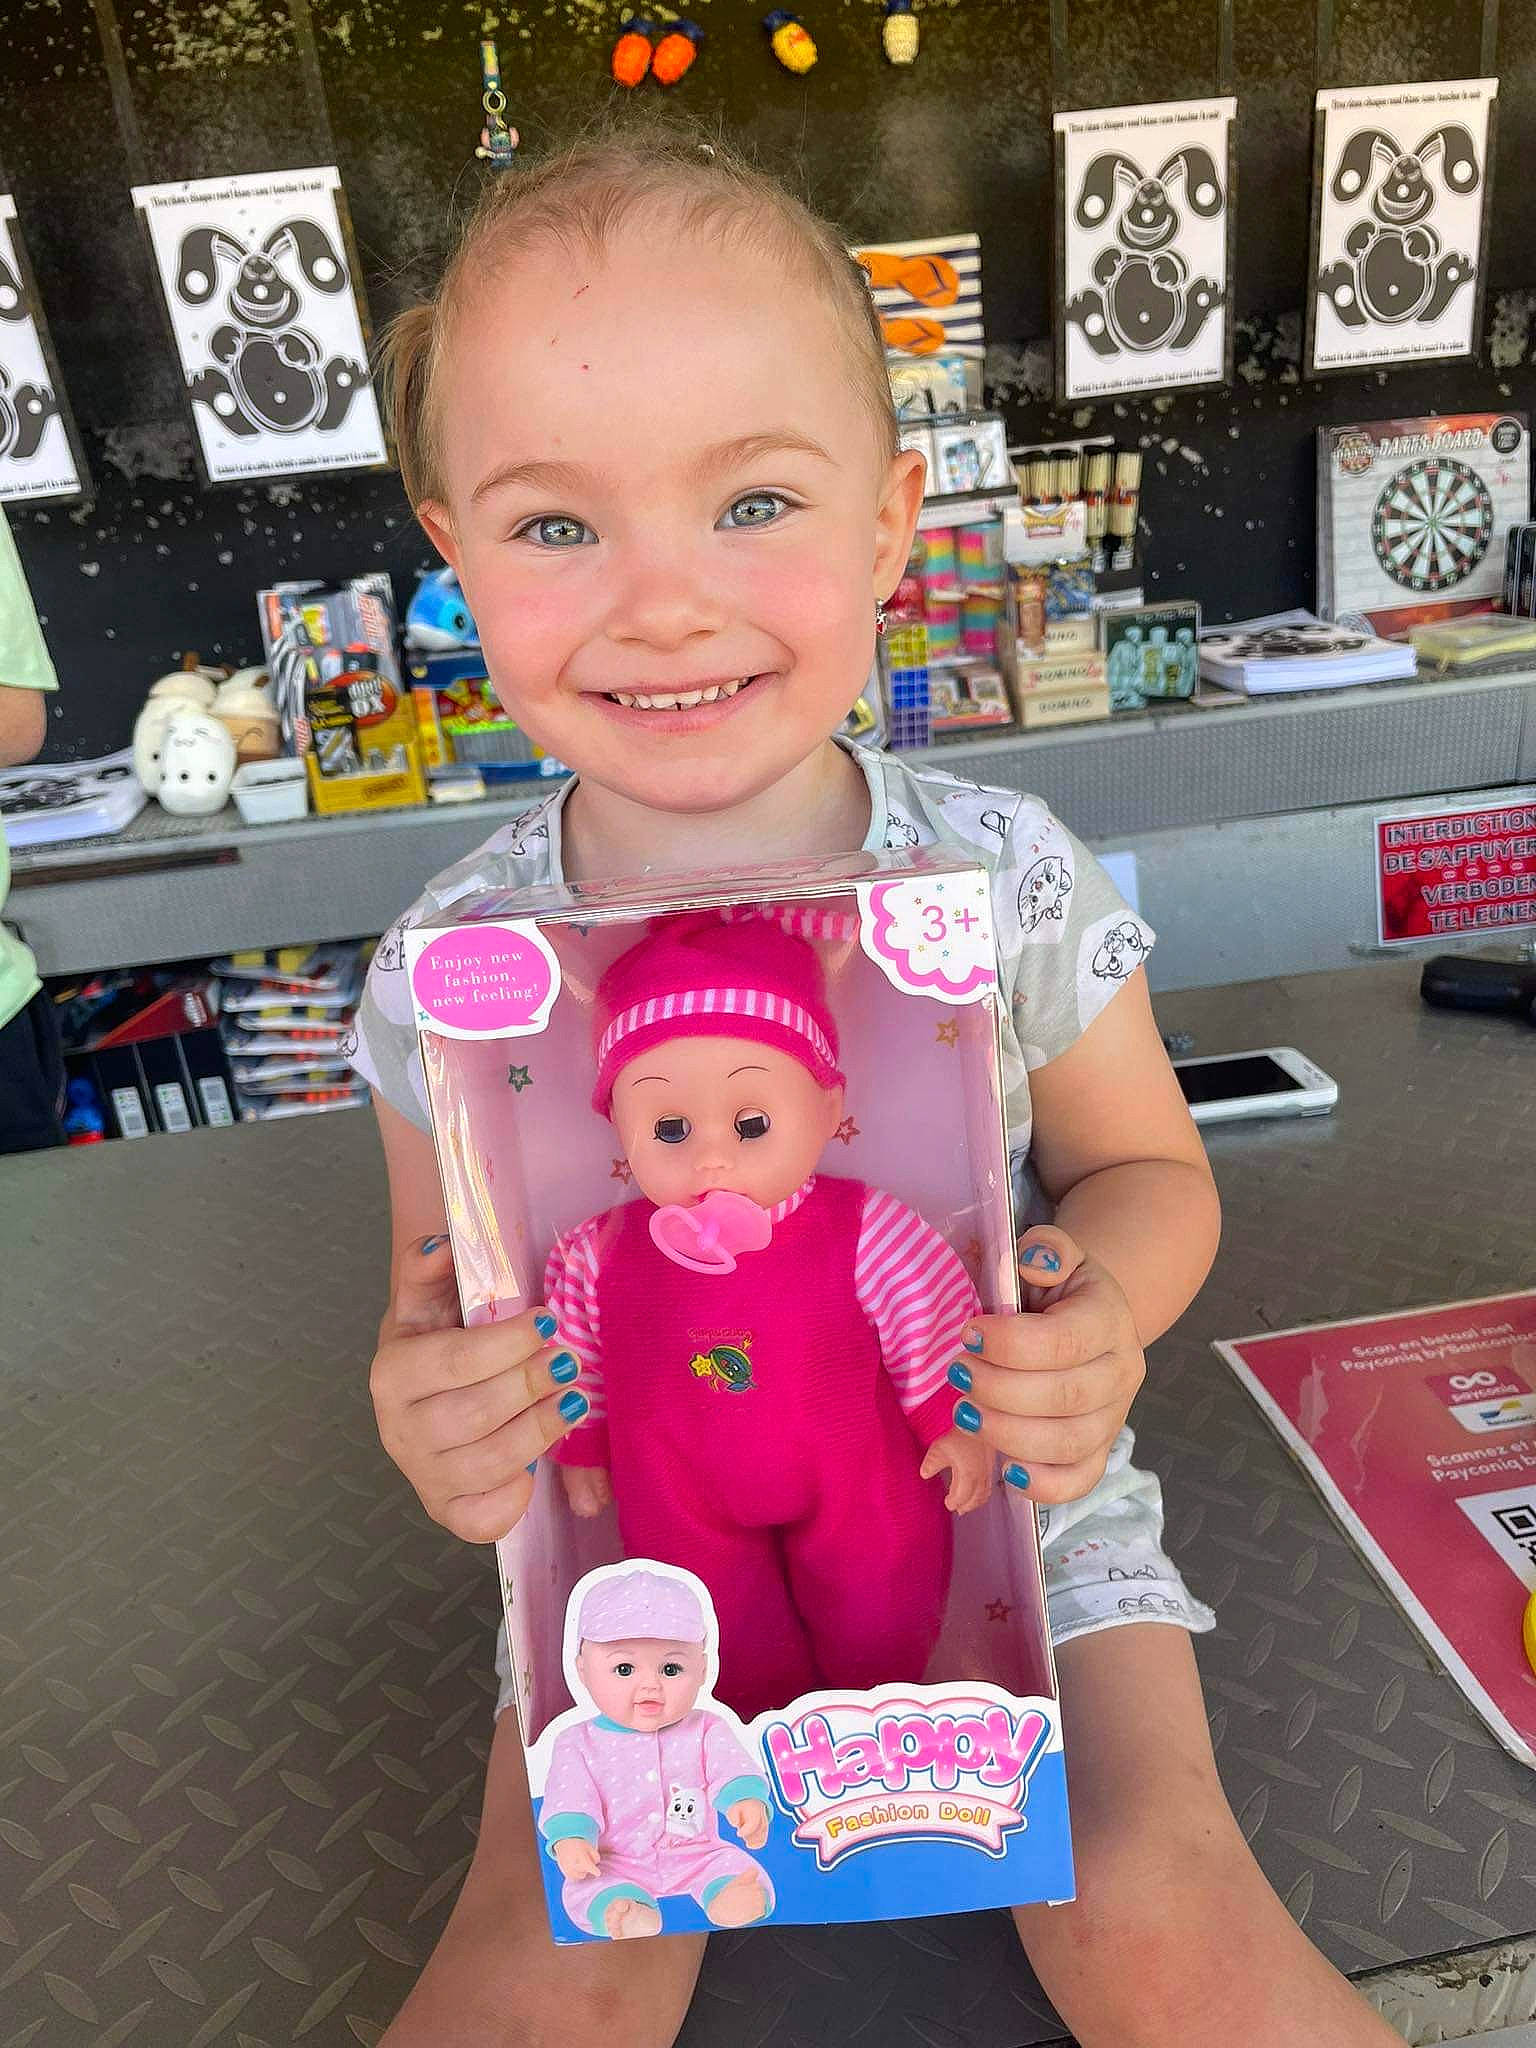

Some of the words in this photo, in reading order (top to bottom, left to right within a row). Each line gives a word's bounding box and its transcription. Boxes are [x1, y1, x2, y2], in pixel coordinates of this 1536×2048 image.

[1387, 811, 1536, 845] INTERDICTION
[922, 905, 979, 942] 3+
[1430, 910, 1458, 931] TE
[430, 954, 482, 971] Enjoy
[491, 951, 523, 964] new
[444, 971, 517, 988] fashion,
[432, 995, 465, 1008] new
[472, 984, 539, 1003] feeling!
[1352, 1343, 1396, 1358] Scan
[1399, 1339, 1421, 1350] en
[1340, 1350, 1424, 1372] Payconiq
[1427, 1446, 1508, 1467] Scannez
[1511, 1440, 1528, 1452] et
[1432, 1459, 1523, 1481] Payconiq
[767, 1708, 1047, 1803] Happy
[825, 1803, 929, 1838] Fashion
[939, 1802, 991, 1826] Doll
